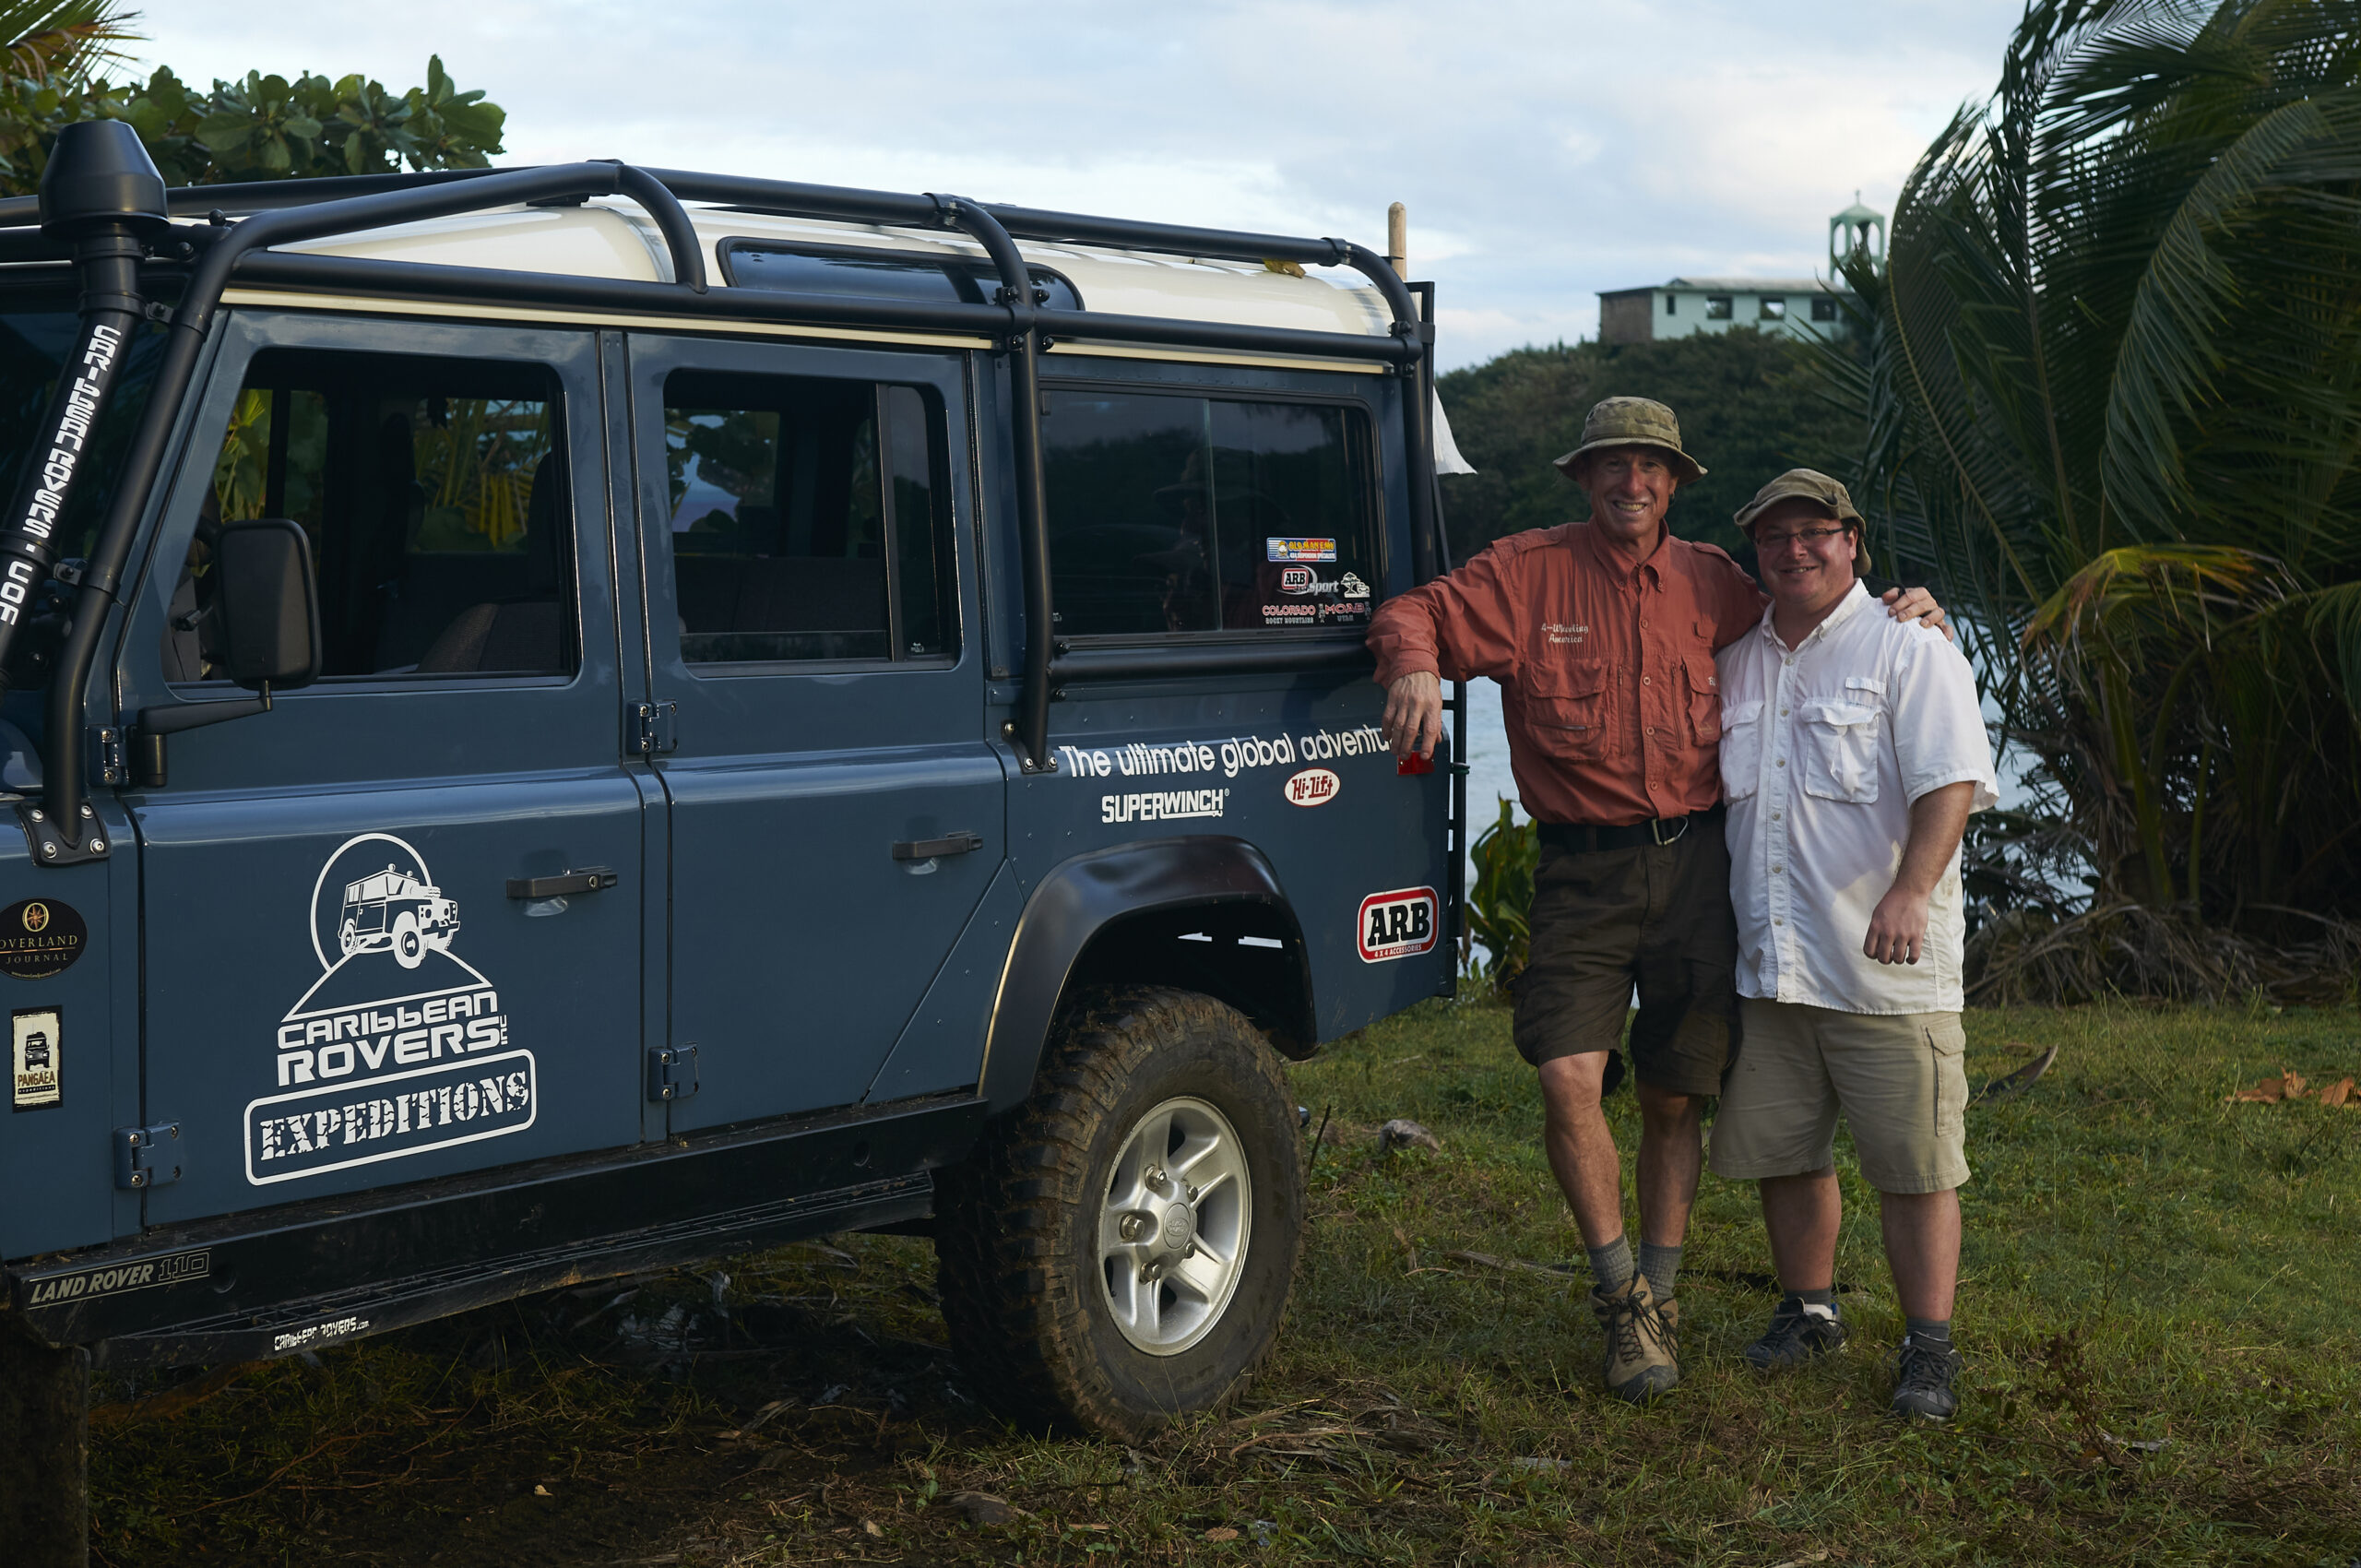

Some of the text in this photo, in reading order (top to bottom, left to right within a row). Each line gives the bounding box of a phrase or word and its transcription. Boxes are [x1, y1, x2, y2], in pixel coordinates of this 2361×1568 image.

[1285, 573, 1305, 585] ARB
[1262, 605, 1316, 616] COLORADO
[1324, 602, 1365, 614] MOAB
[1059, 724, 1392, 778] The ultimate global adventu
[1367, 901, 1430, 947] ARB
[0, 934, 77, 949] OVERLAND
[1389, 944, 1422, 956] ACCESSORIES
[6, 953, 68, 965] JOURNAL
[278, 1016, 500, 1087] ROVERS
[18, 1071, 55, 1087] PANGAEA
[260, 1070, 529, 1161] EXPEDITIONS
[30, 1252, 210, 1304] LAND ROVER 110
